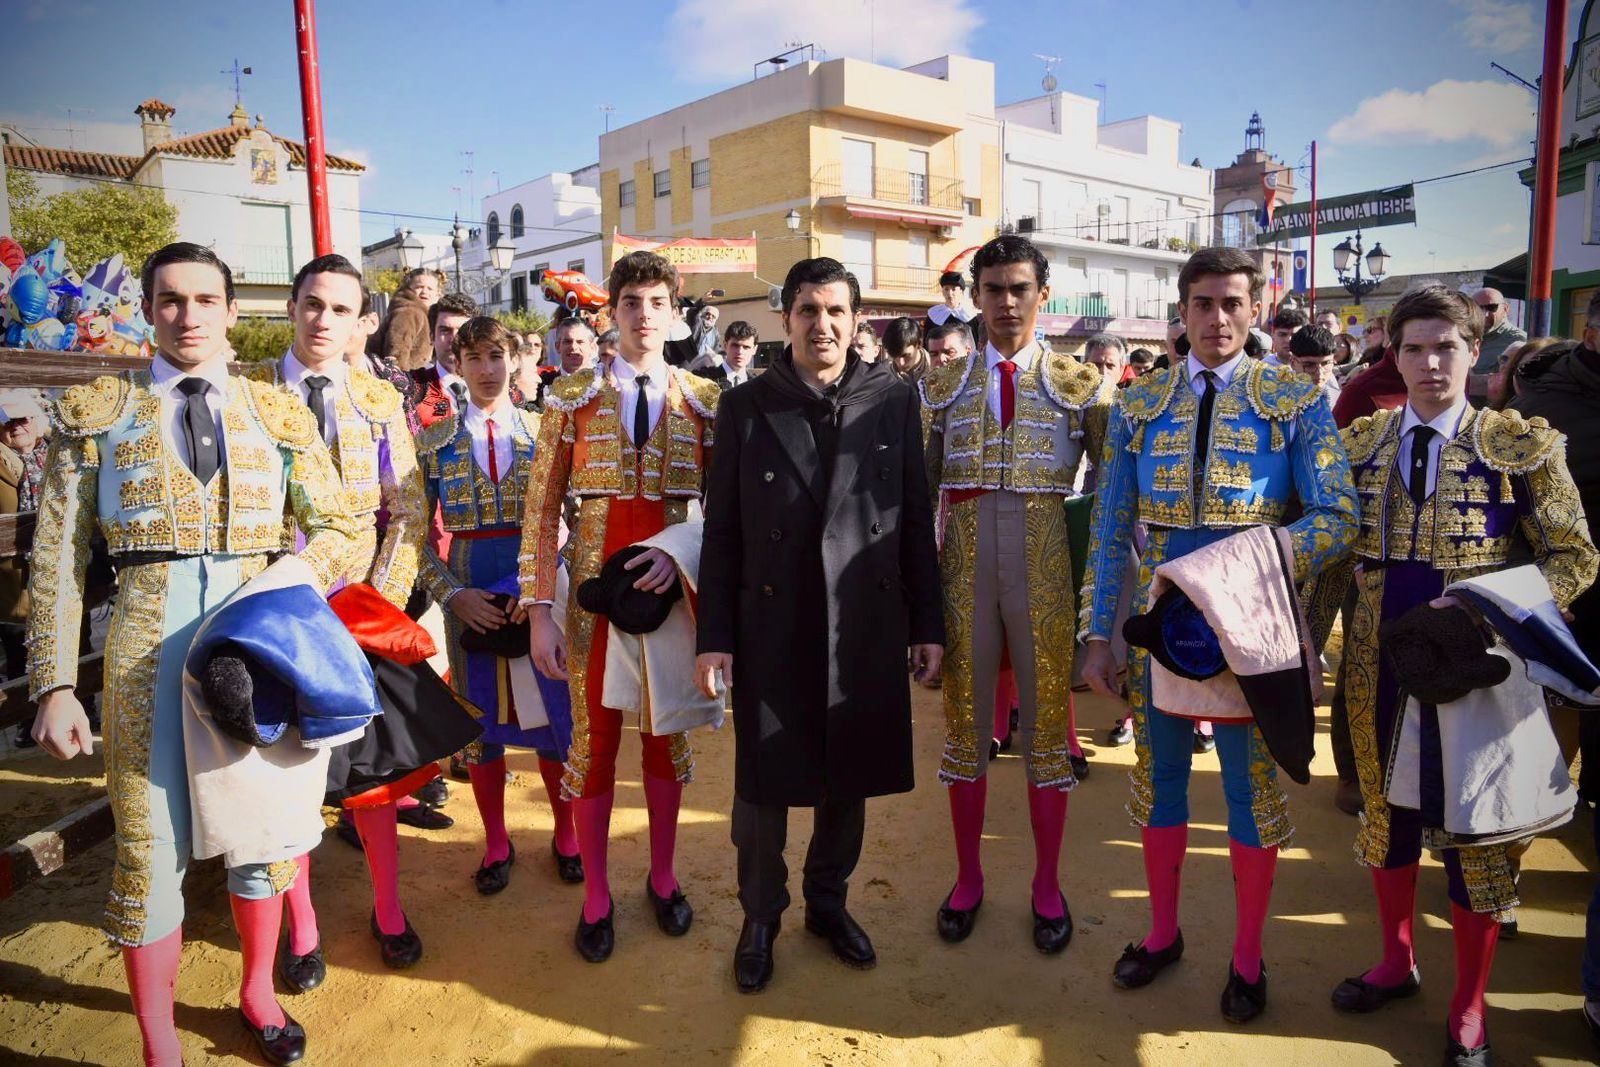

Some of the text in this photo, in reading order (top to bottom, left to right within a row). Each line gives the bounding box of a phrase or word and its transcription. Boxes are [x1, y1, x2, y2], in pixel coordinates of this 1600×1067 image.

[1369, 197, 1412, 217] LIBRE
[673, 247, 685, 263] DE
[687, 247, 703, 263] SAN
[1084, 318, 1098, 330] Las
